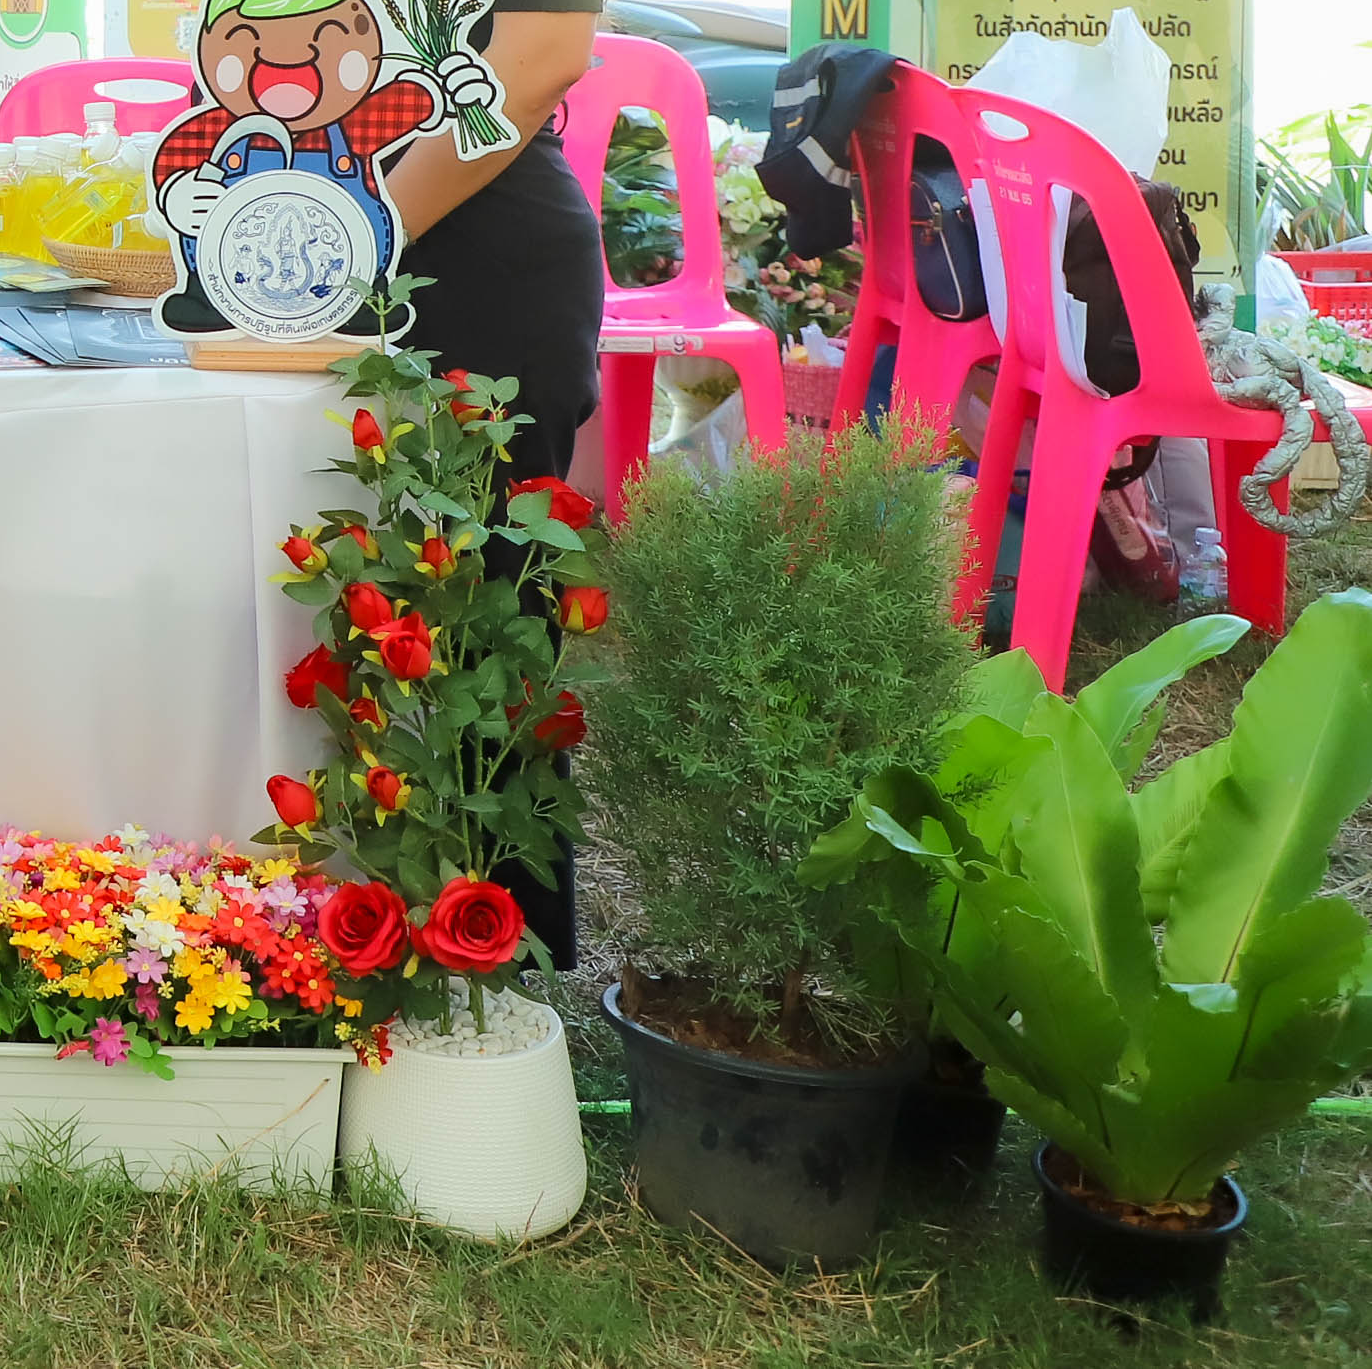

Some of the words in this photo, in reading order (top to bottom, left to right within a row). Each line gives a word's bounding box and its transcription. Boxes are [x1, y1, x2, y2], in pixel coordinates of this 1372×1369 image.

[208, 271, 360, 335] สำนักงานการปฏิรูปที่ดินเพื่อเกษตรกรร
